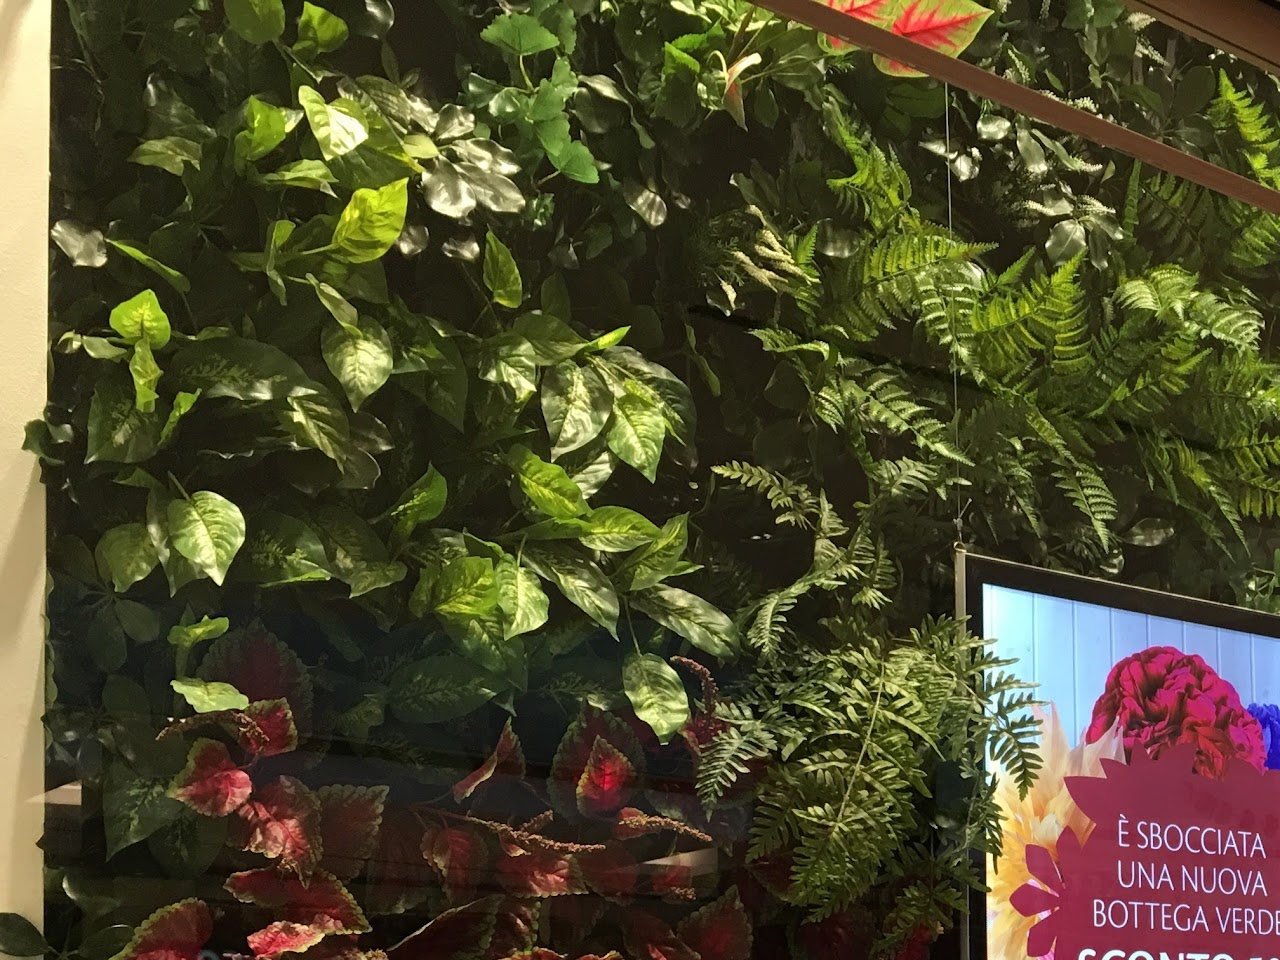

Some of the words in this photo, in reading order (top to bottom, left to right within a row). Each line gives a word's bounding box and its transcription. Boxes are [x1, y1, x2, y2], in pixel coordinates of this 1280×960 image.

[1117, 813, 1131, 848] È
[1136, 820, 1267, 860] SBOCCIATA
[1117, 859, 1175, 892] UNA
[1181, 864, 1268, 897] NUOVA
[1092, 898, 1210, 933] BOTTEGA
